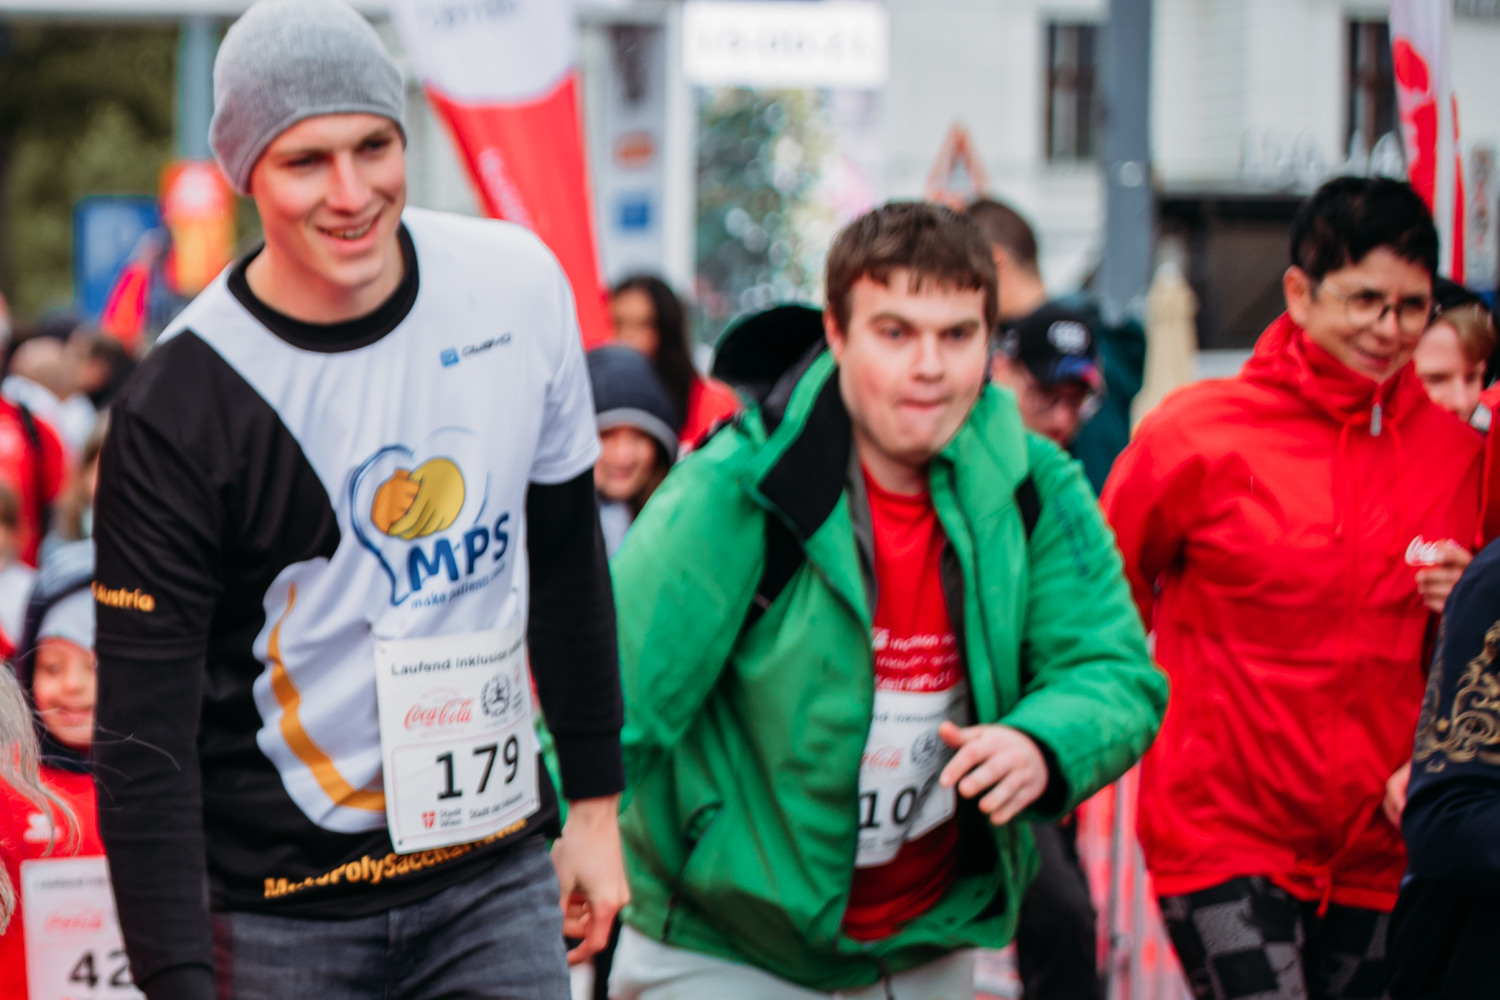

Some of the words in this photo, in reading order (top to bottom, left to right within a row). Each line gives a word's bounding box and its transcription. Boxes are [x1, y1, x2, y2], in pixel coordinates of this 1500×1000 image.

[406, 511, 510, 592] MPS
[391, 658, 452, 676] Laufend
[435, 733, 520, 800] 179
